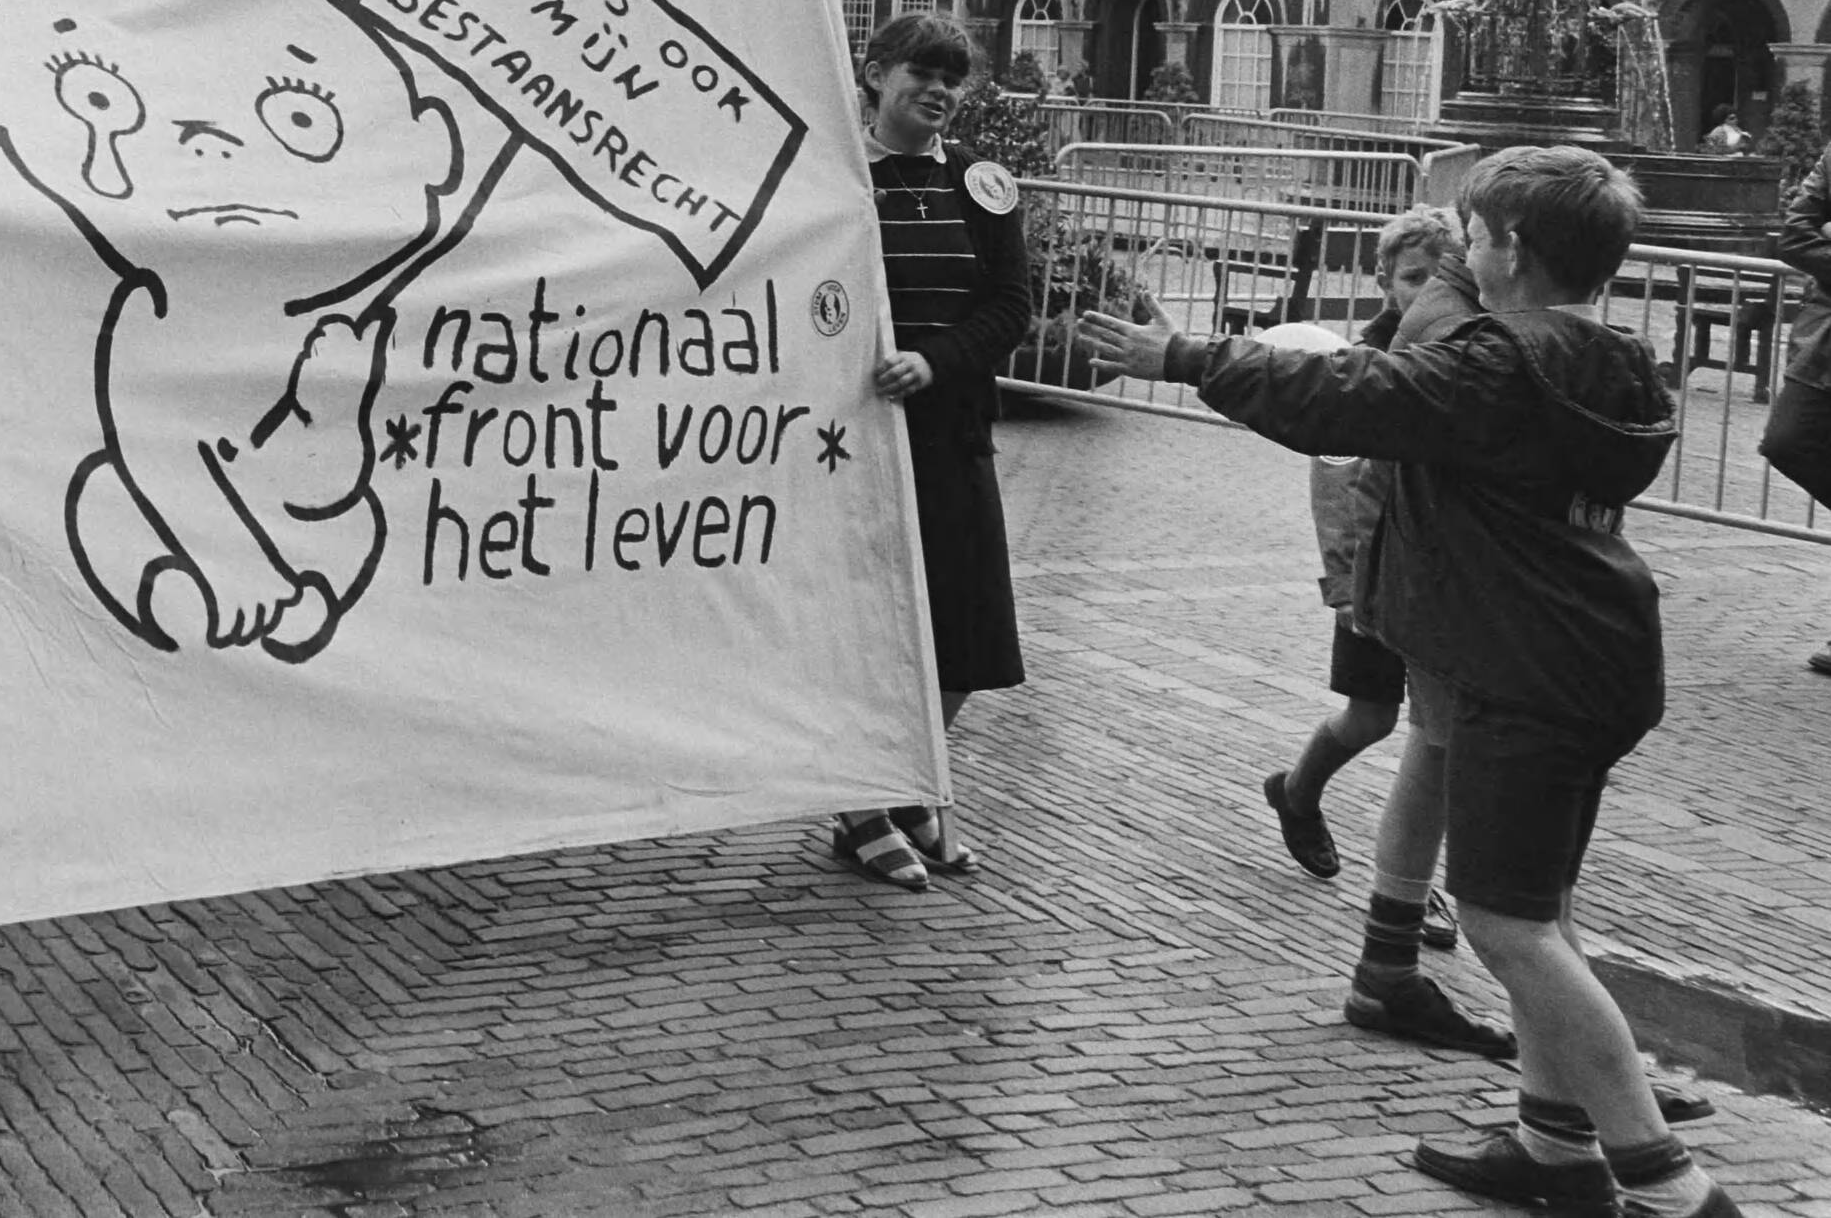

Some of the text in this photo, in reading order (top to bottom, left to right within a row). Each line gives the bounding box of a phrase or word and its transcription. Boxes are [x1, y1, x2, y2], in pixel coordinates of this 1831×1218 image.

[658, 38, 751, 123] OOK
[423, 276, 779, 384] nationaal
[423, 379, 811, 471] front voor
[422, 467, 777, 586] het leven
